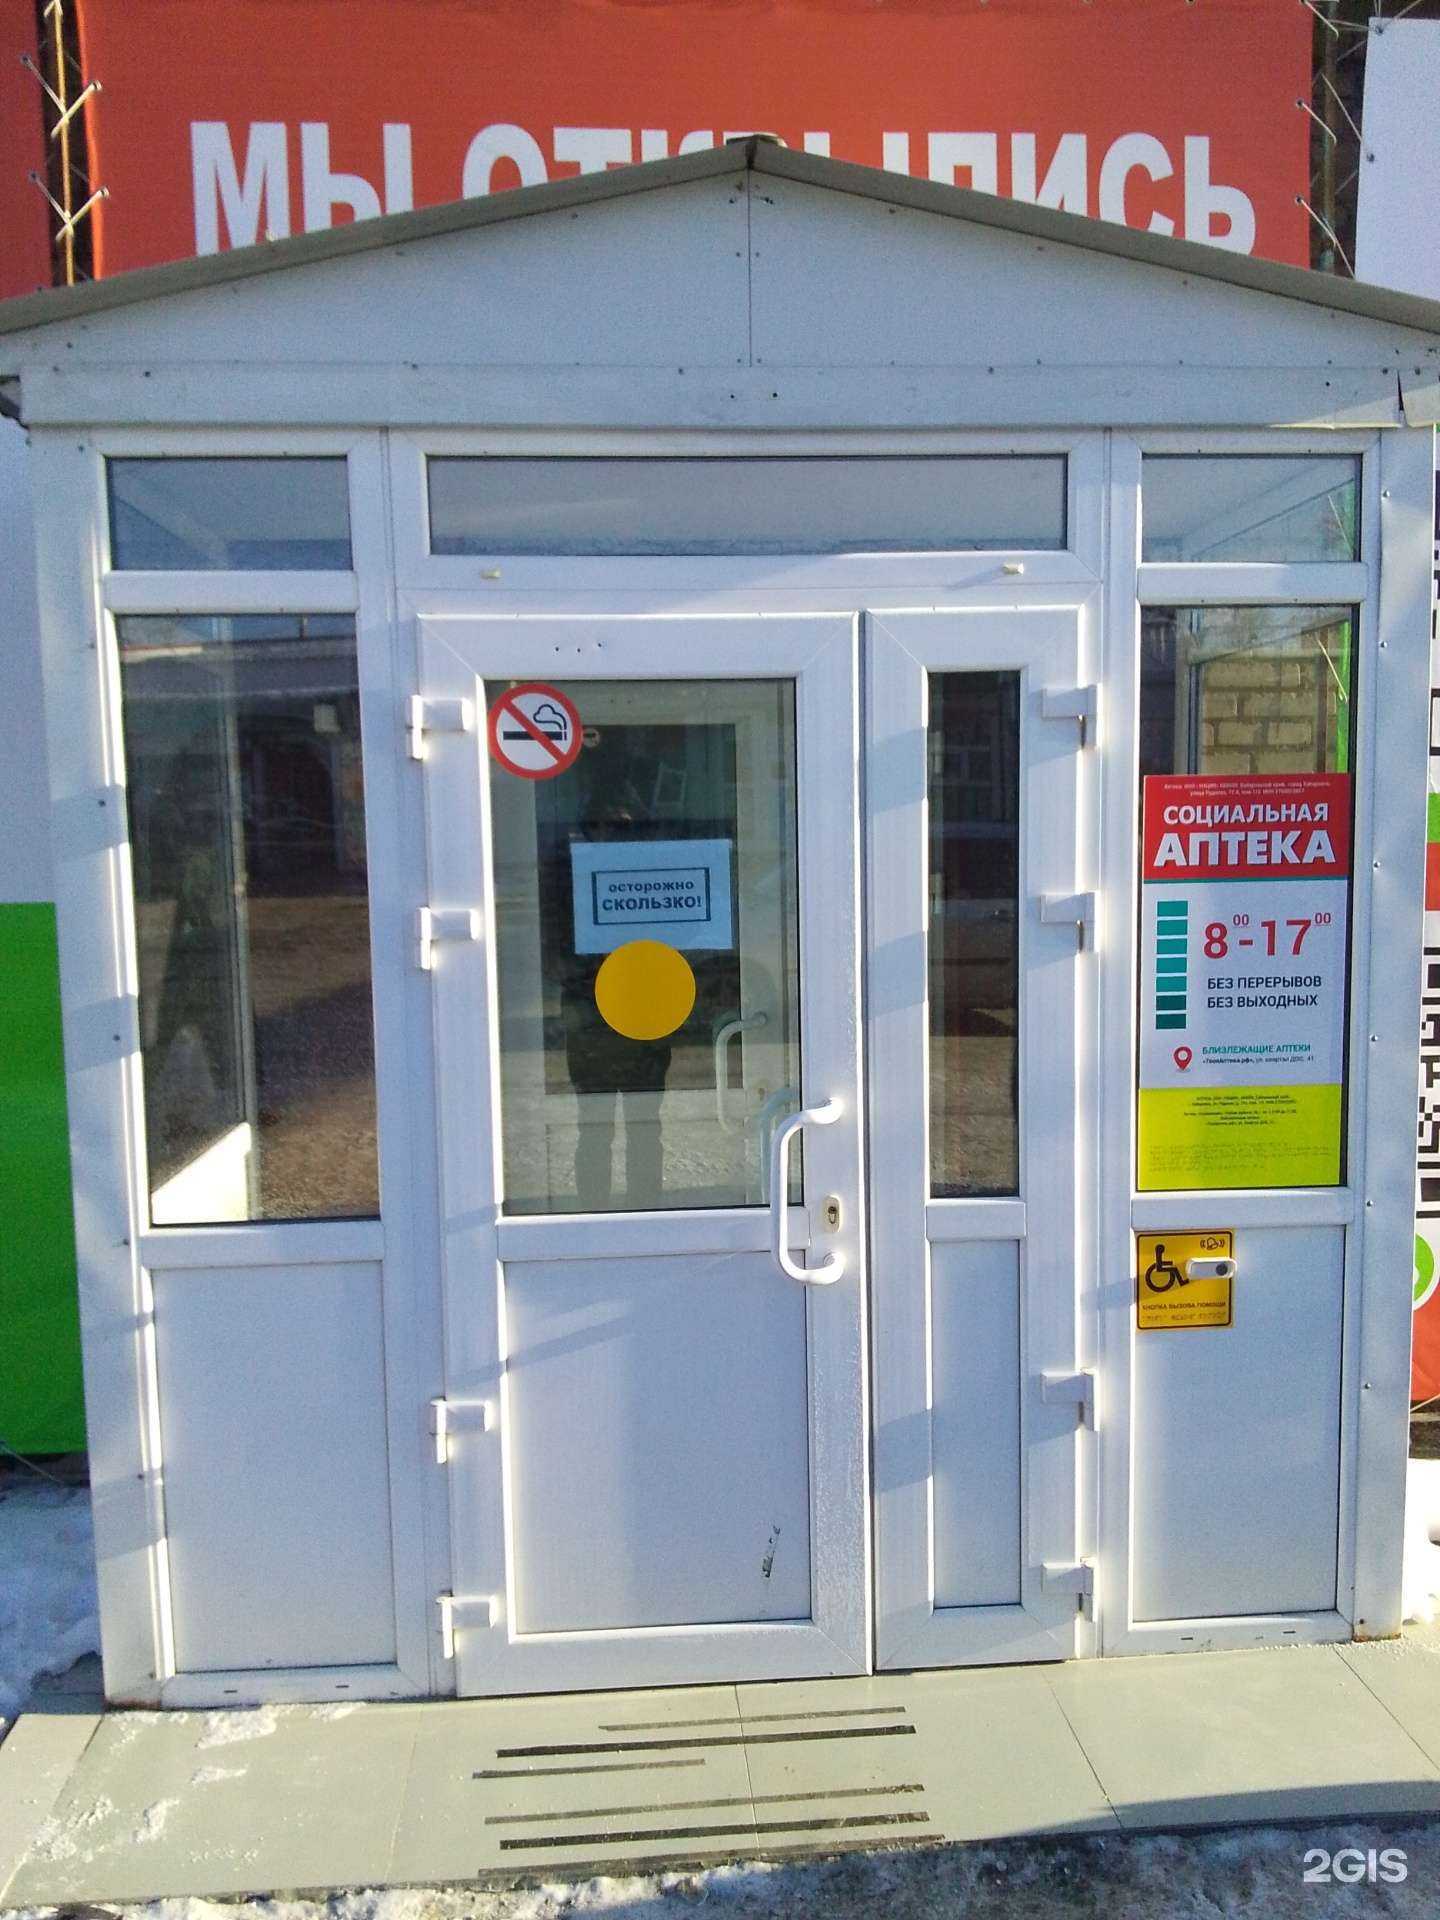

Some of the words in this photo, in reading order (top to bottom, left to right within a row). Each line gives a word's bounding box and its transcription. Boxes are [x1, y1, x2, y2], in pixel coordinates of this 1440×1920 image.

[190, 121, 414, 257] МЫ
[1163, 803, 1329, 827] СОЦИАЛЬНАЯ
[1153, 830, 1336, 867] АПТЕКА
[602, 896, 702, 911] СКОЛЬЗКО!
[1207, 978, 1234, 990] БЕЗ
[1237, 976, 1322, 989] ПЕРЕРЫВОВ
[1207, 996, 1234, 1009] БЕЗ
[1237, 995, 1319, 1009] ВЫХОДНЫХ
[1202, 1046, 1274, 1055] БЛИЗЛЕЖАЩИЕ
[1276, 1044, 1311, 1053] АПТЕКИ
